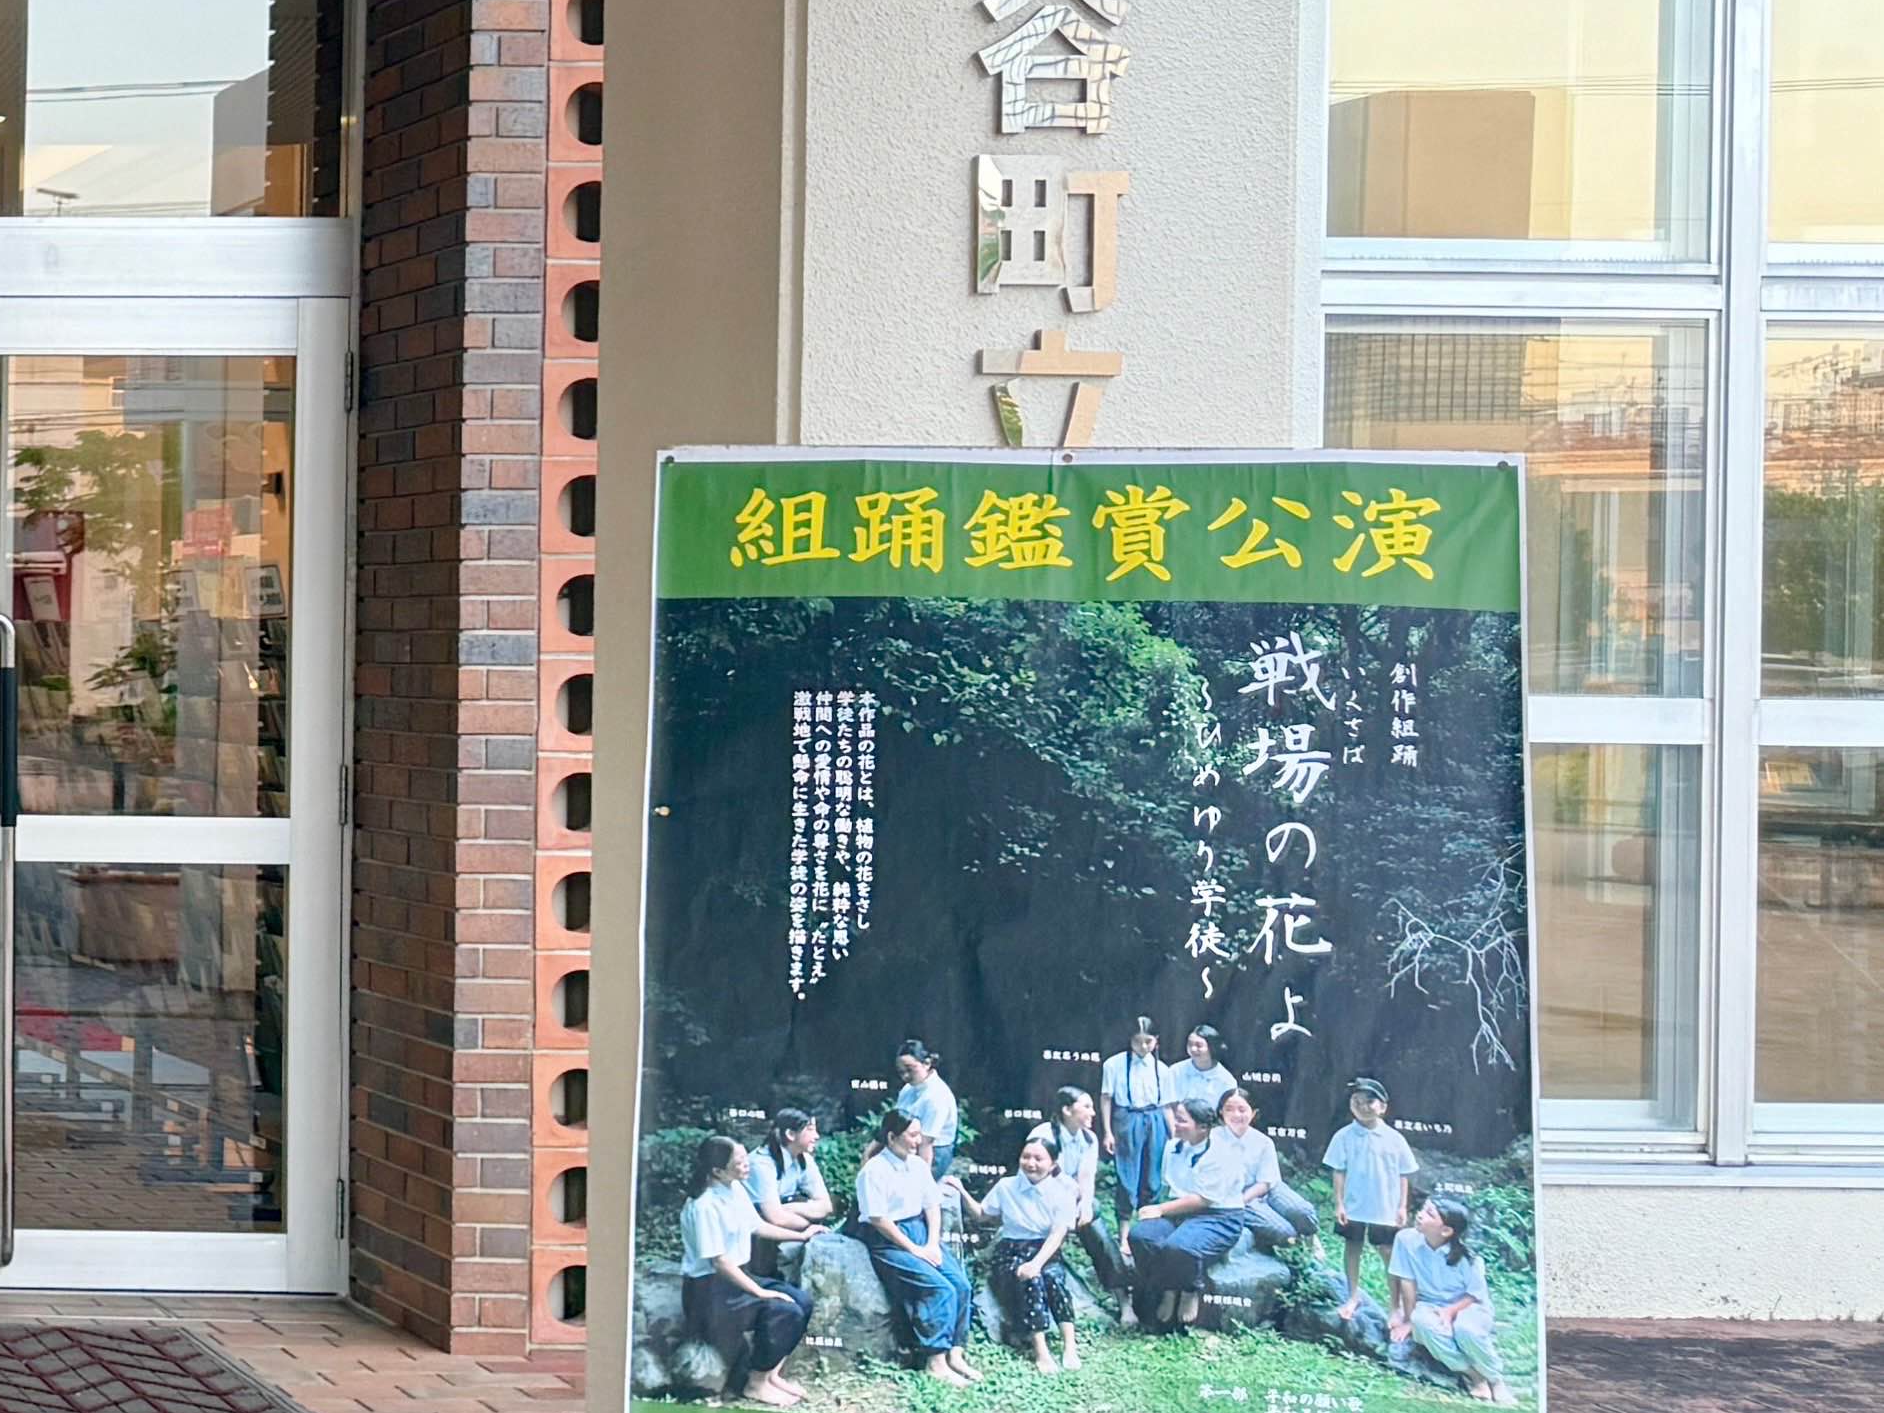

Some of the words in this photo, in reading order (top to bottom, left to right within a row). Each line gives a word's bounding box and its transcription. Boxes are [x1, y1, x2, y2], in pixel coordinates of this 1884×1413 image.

[729, 484, 1441, 582] 組踊鑑賞公演
[1342, 667, 1365, 764] いくさば
[1390, 662, 1418, 767] 創作組踊
[1238, 631, 1336, 1040] 戦場の花よ
